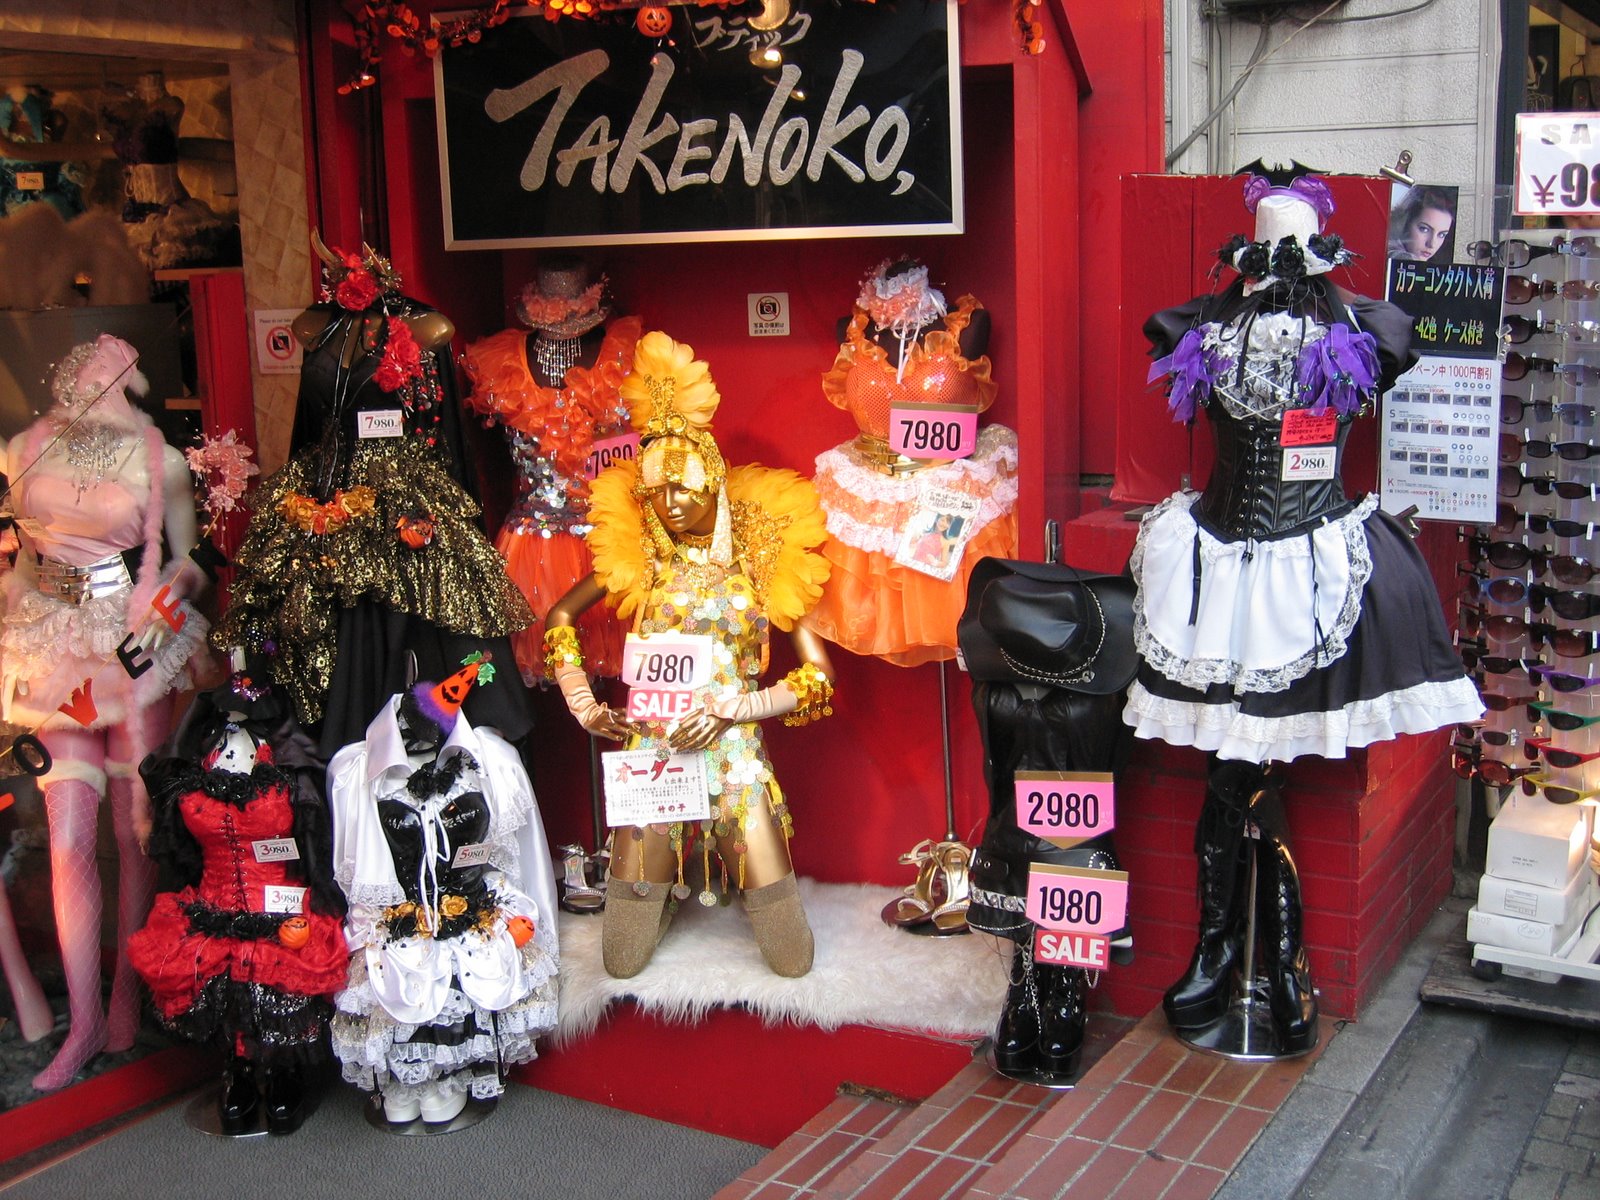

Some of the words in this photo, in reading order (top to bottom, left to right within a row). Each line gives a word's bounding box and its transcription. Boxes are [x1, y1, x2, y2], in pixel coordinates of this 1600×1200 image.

[1396, 262, 1495, 300] カラーコンタクト入荷
[1444, 318, 1484, 345] ケース付き
[1449, 365, 1492, 380] 1000円割引
[364, 415, 395, 429] 7980
[1389, 409, 1396, 418] S
[900, 419, 961, 451] 7980
[1388, 438, 1394, 447] C
[1290, 453, 1325, 470] 2980
[1387, 478, 1394, 487] K
[633, 652, 694, 685] 7980
[632, 691, 692, 720] SALE
[1027, 791, 1099, 829] 2980
[260, 844, 289, 856] 3980
[272, 890, 300, 904] 3980
[1039, 886, 1102, 925] 1980
[1040, 934, 1105, 967] SALE
